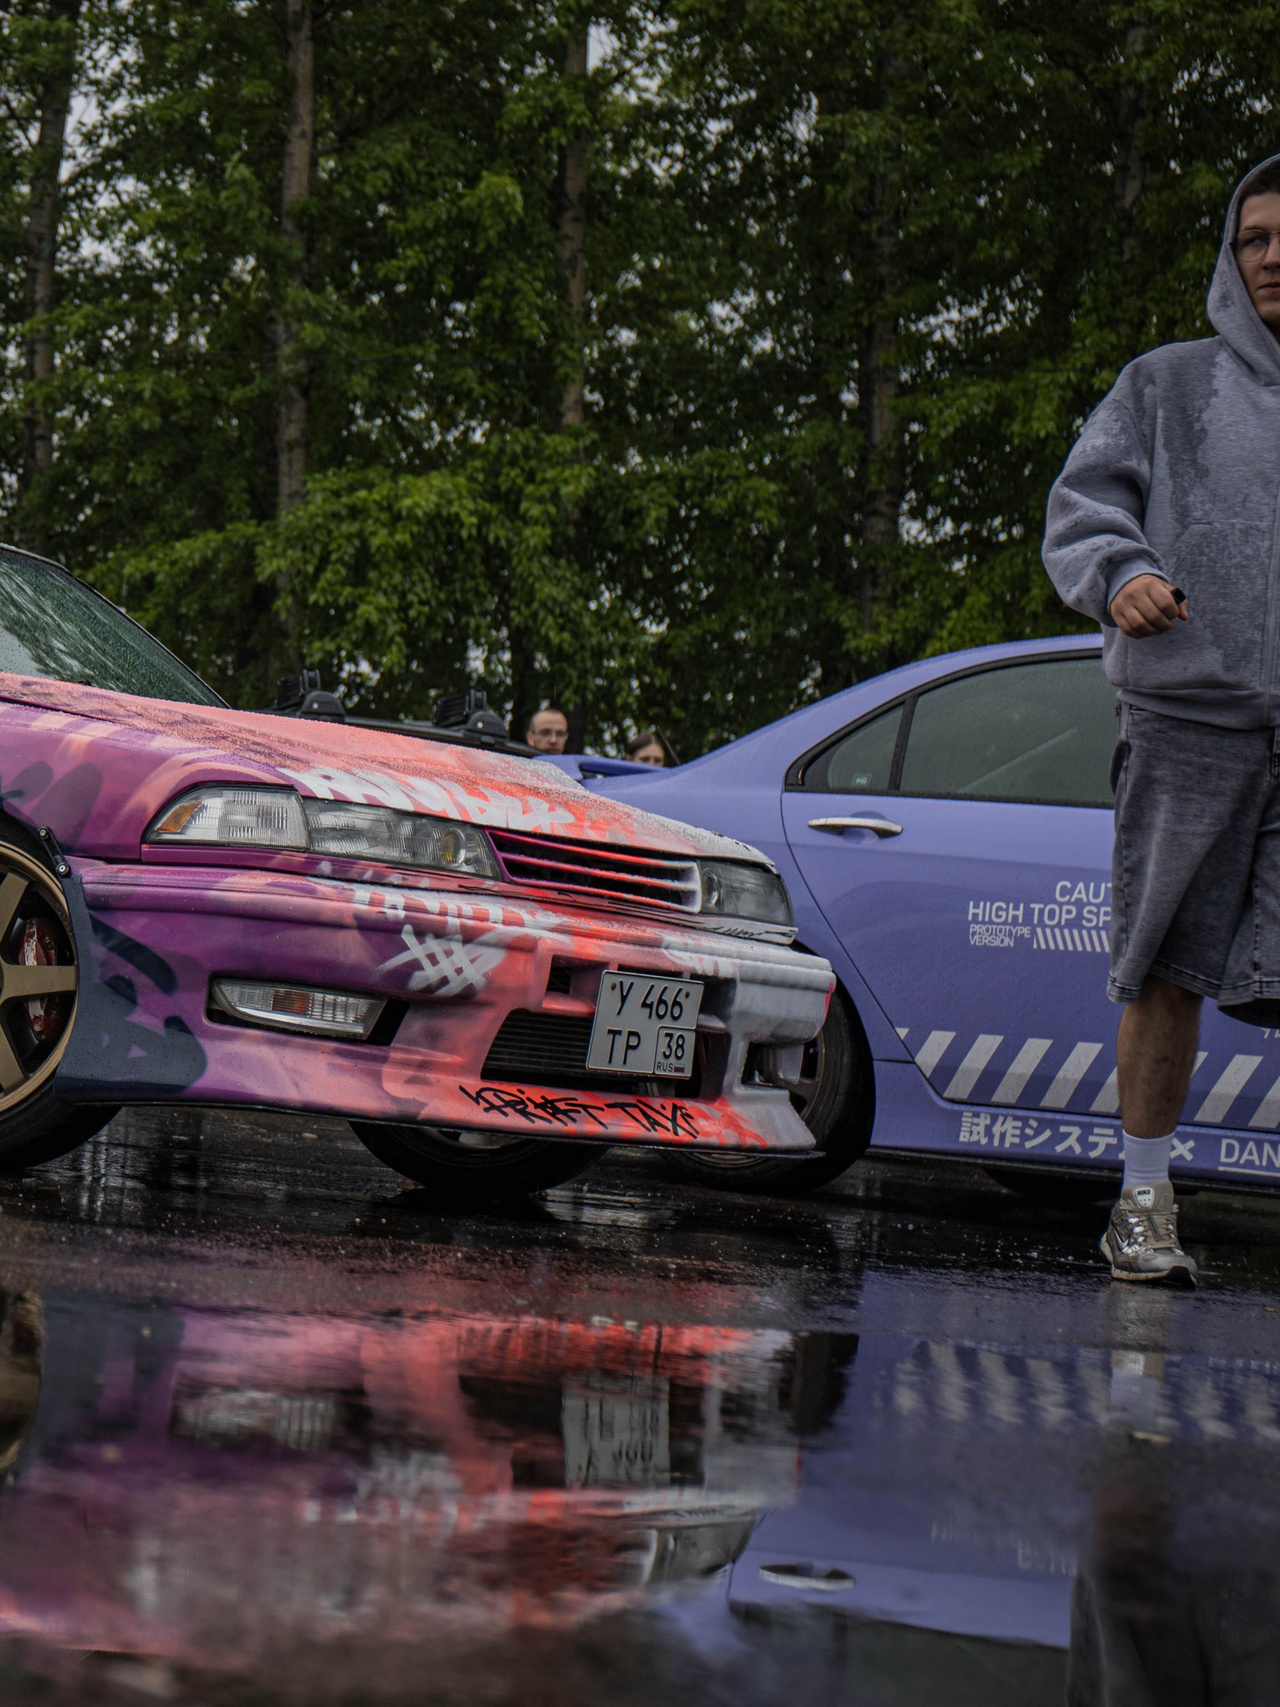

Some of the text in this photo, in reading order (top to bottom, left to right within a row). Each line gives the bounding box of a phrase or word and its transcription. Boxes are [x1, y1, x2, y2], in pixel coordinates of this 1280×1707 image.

[1055, 880, 1112, 904] CAU
[968, 900, 1024, 924] HIGH
[1030, 904, 1077, 926] TOP
[970, 924, 1032, 938] PROTOTYPE
[970, 934, 1015, 948] VERSION
[641, 984, 683, 1020] 466
[663, 1032, 685, 1060] 38
[656, 1061, 674, 1072] RUS
[959, 1111, 1125, 1160] 試作システ
[1220, 1138, 1280, 1168] DAN
